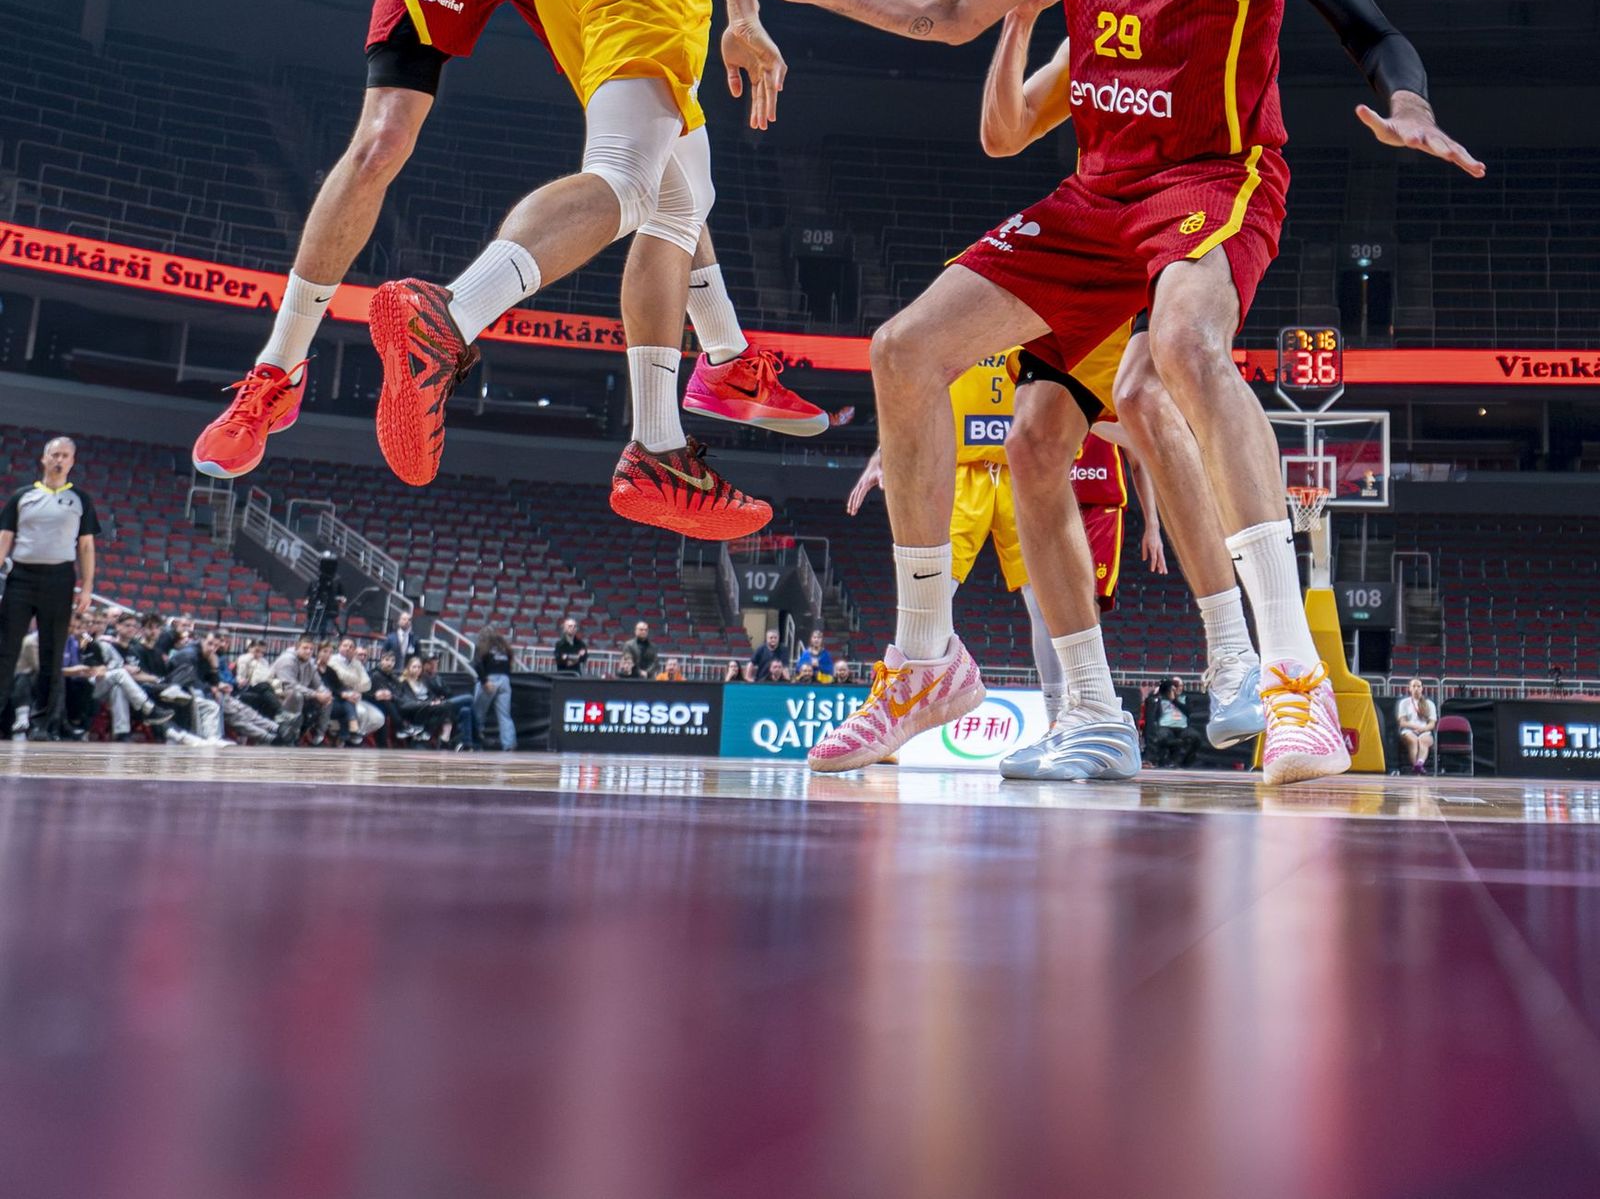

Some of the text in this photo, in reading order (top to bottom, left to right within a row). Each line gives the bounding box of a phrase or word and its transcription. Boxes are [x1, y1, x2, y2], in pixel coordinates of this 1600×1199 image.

[1094, 11, 1143, 60] 29
[1070, 78, 1172, 118] endesa
[162, 260, 257, 299] SuPer
[486, 311, 626, 346] ienkārš
[1296, 329, 1336, 351] 7:16
[991, 377, 1003, 404] 5
[1068, 465, 1107, 481] desa
[744, 571, 780, 591] 107
[1345, 588, 1382, 608] 108
[605, 701, 709, 726] TISSOT
[786, 691, 864, 721] visit
[563, 724, 596, 733] SWISS
[600, 724, 647, 734] WATCHES
[650, 725, 681, 735] SINCE
[752, 718, 834, 753] QATA
[953, 716, 1012, 741] 伊利
[1567, 726, 1600, 749] TI
[1522, 748, 1558, 758] SWISS
